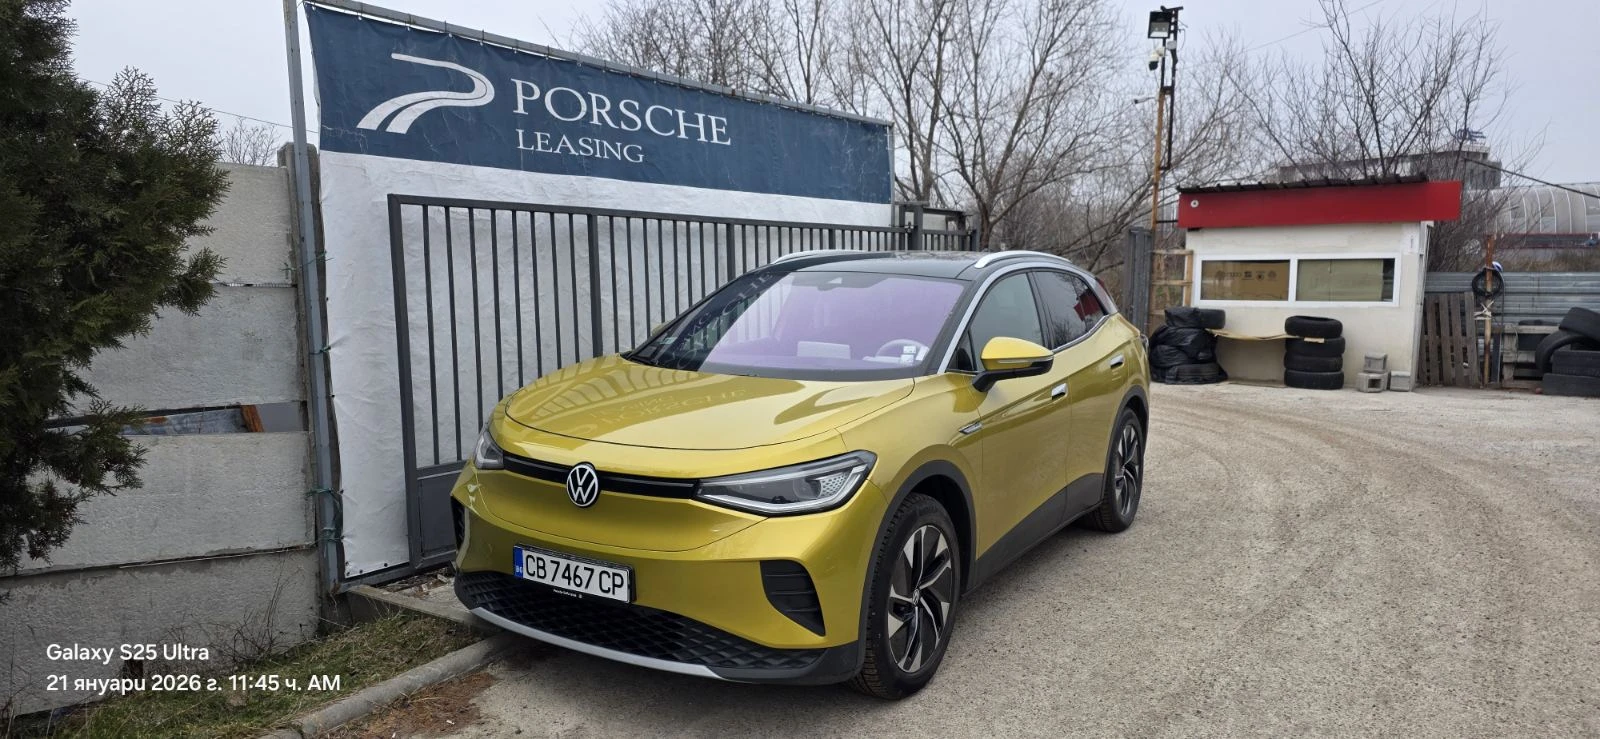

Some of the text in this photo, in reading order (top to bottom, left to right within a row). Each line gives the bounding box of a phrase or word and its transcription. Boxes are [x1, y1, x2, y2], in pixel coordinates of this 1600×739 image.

[511, 78, 731, 146] PORSCHE
[516, 129, 644, 163] LEASING
[525, 554, 624, 595] CB 7467 CP
